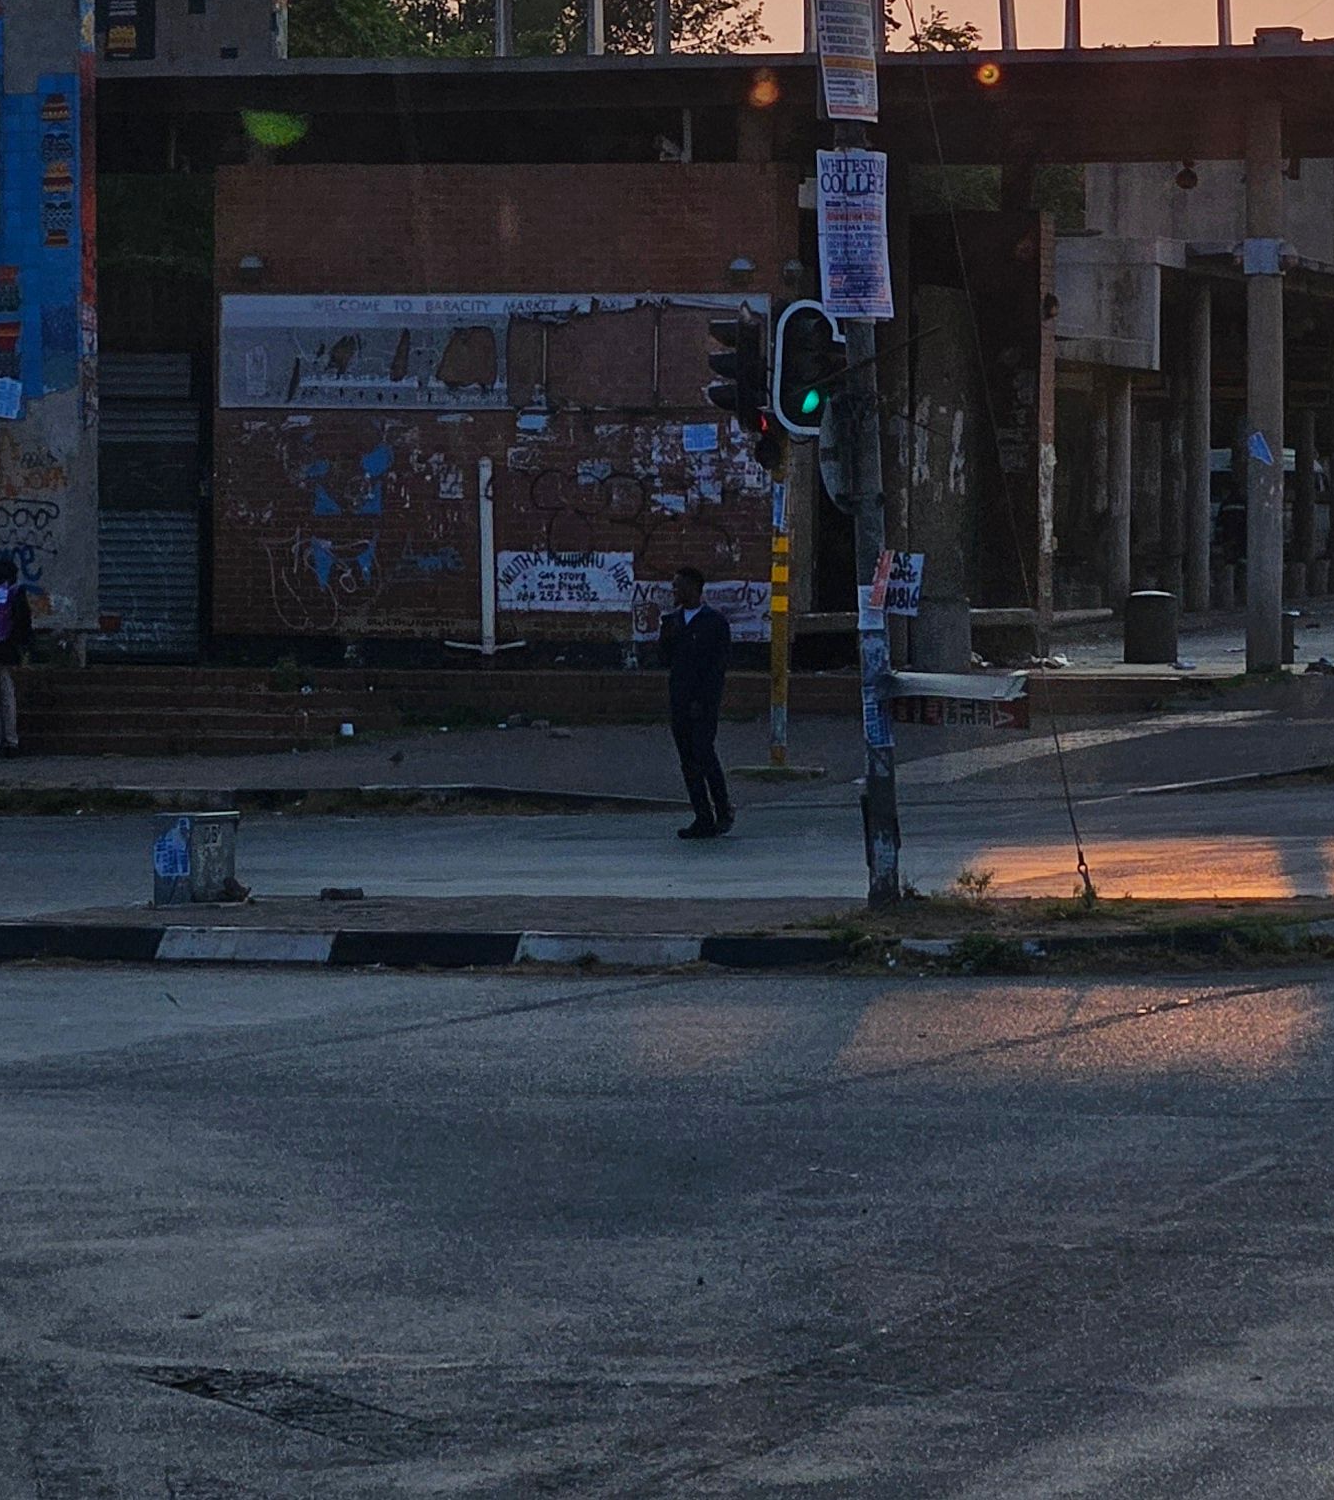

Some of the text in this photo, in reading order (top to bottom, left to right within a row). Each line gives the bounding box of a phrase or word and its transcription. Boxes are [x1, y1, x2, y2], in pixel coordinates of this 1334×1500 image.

[312, 299, 381, 312] WELCOME
[393, 299, 413, 312] TO
[425, 299, 491, 312] BARACITY
[503, 299, 557, 312] MARKET
